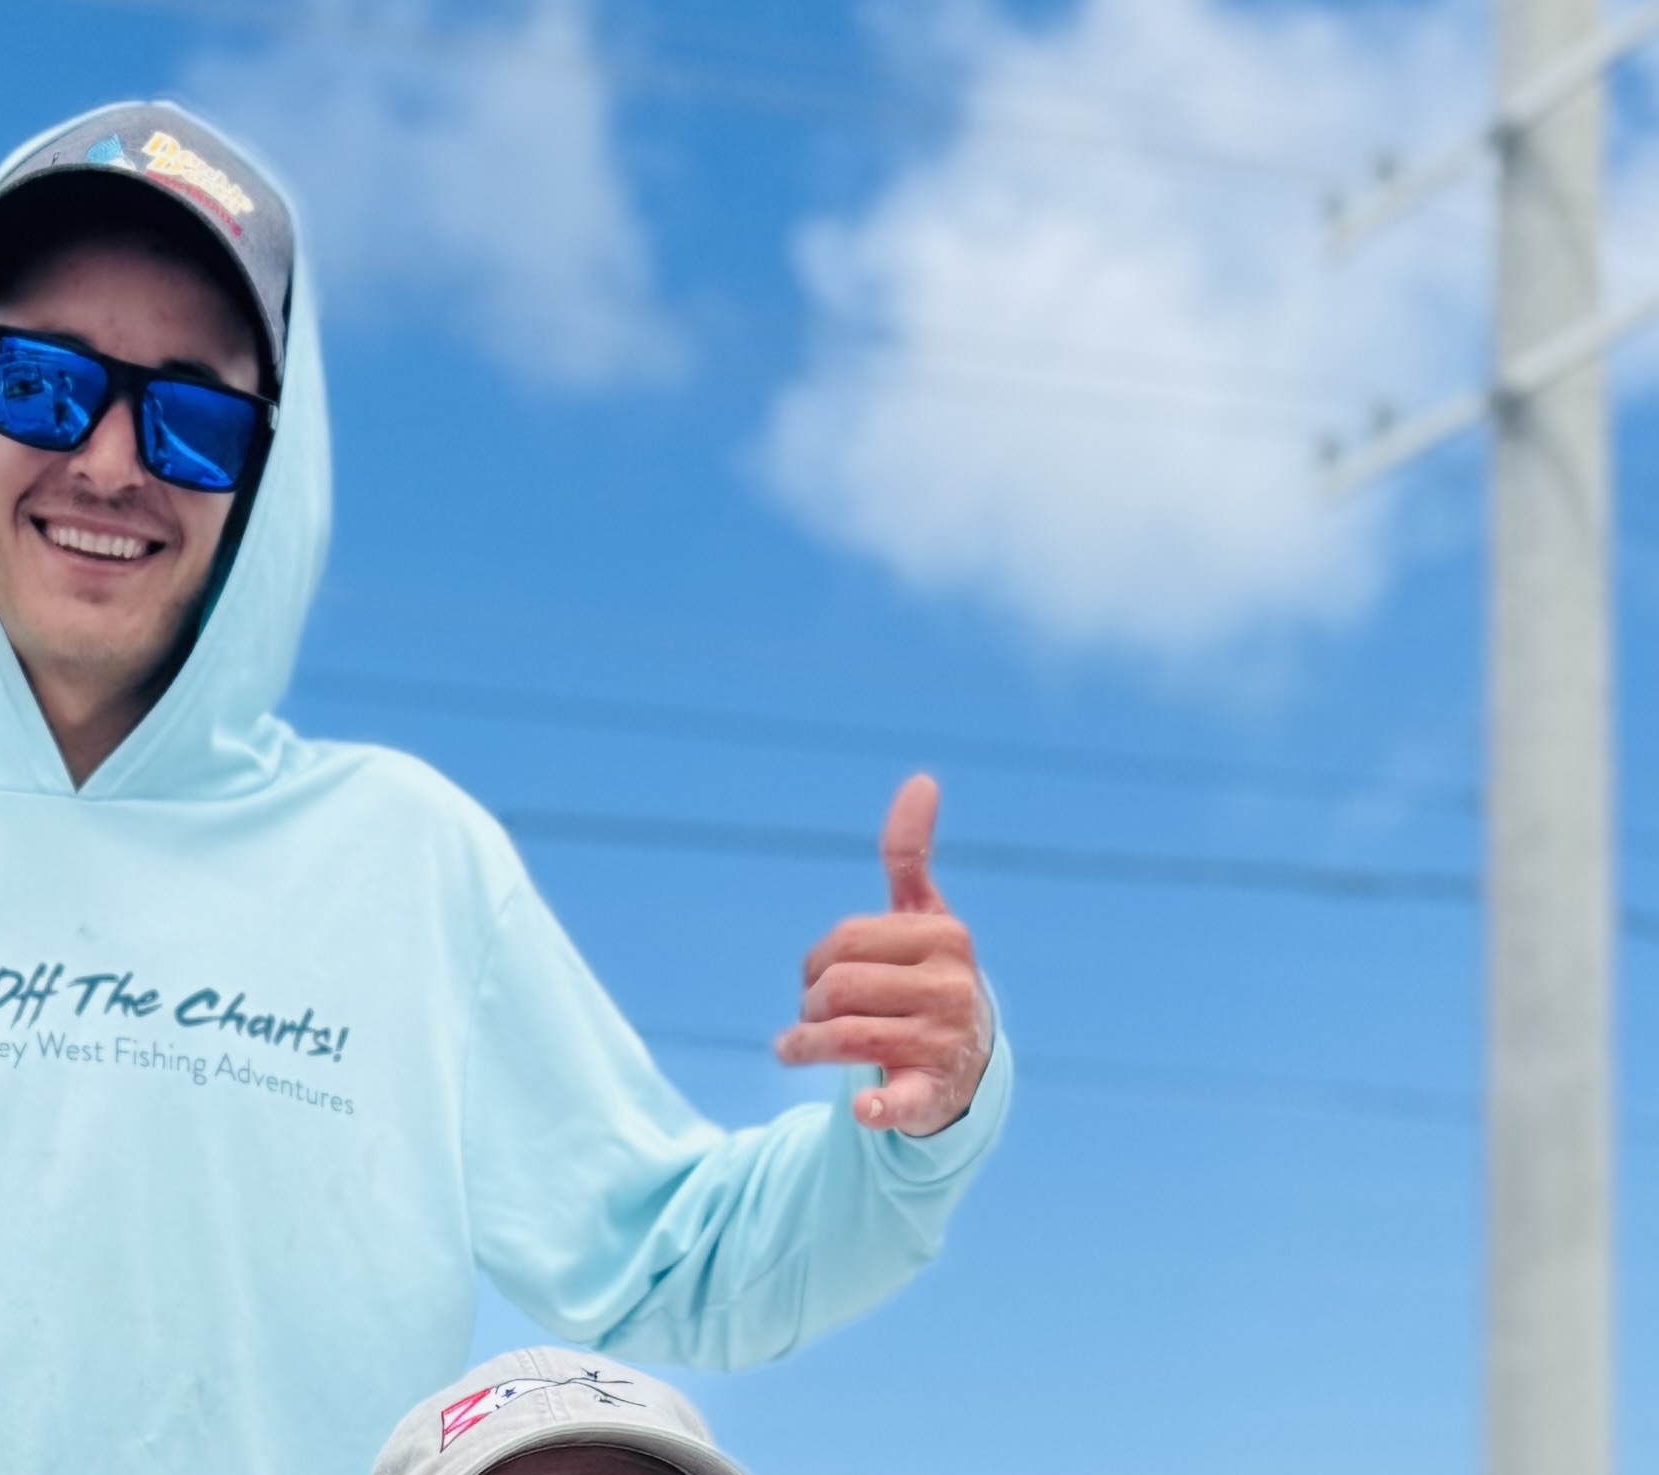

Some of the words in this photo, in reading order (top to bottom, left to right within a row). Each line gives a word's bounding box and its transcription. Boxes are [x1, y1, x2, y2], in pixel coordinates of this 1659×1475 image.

[67, 971, 163, 1018] The
[174, 987, 349, 1063] Charts!
[37, 1030, 104, 1063] West
[115, 1037, 207, 1085] Fishing
[215, 1053, 354, 1115] Adventures
